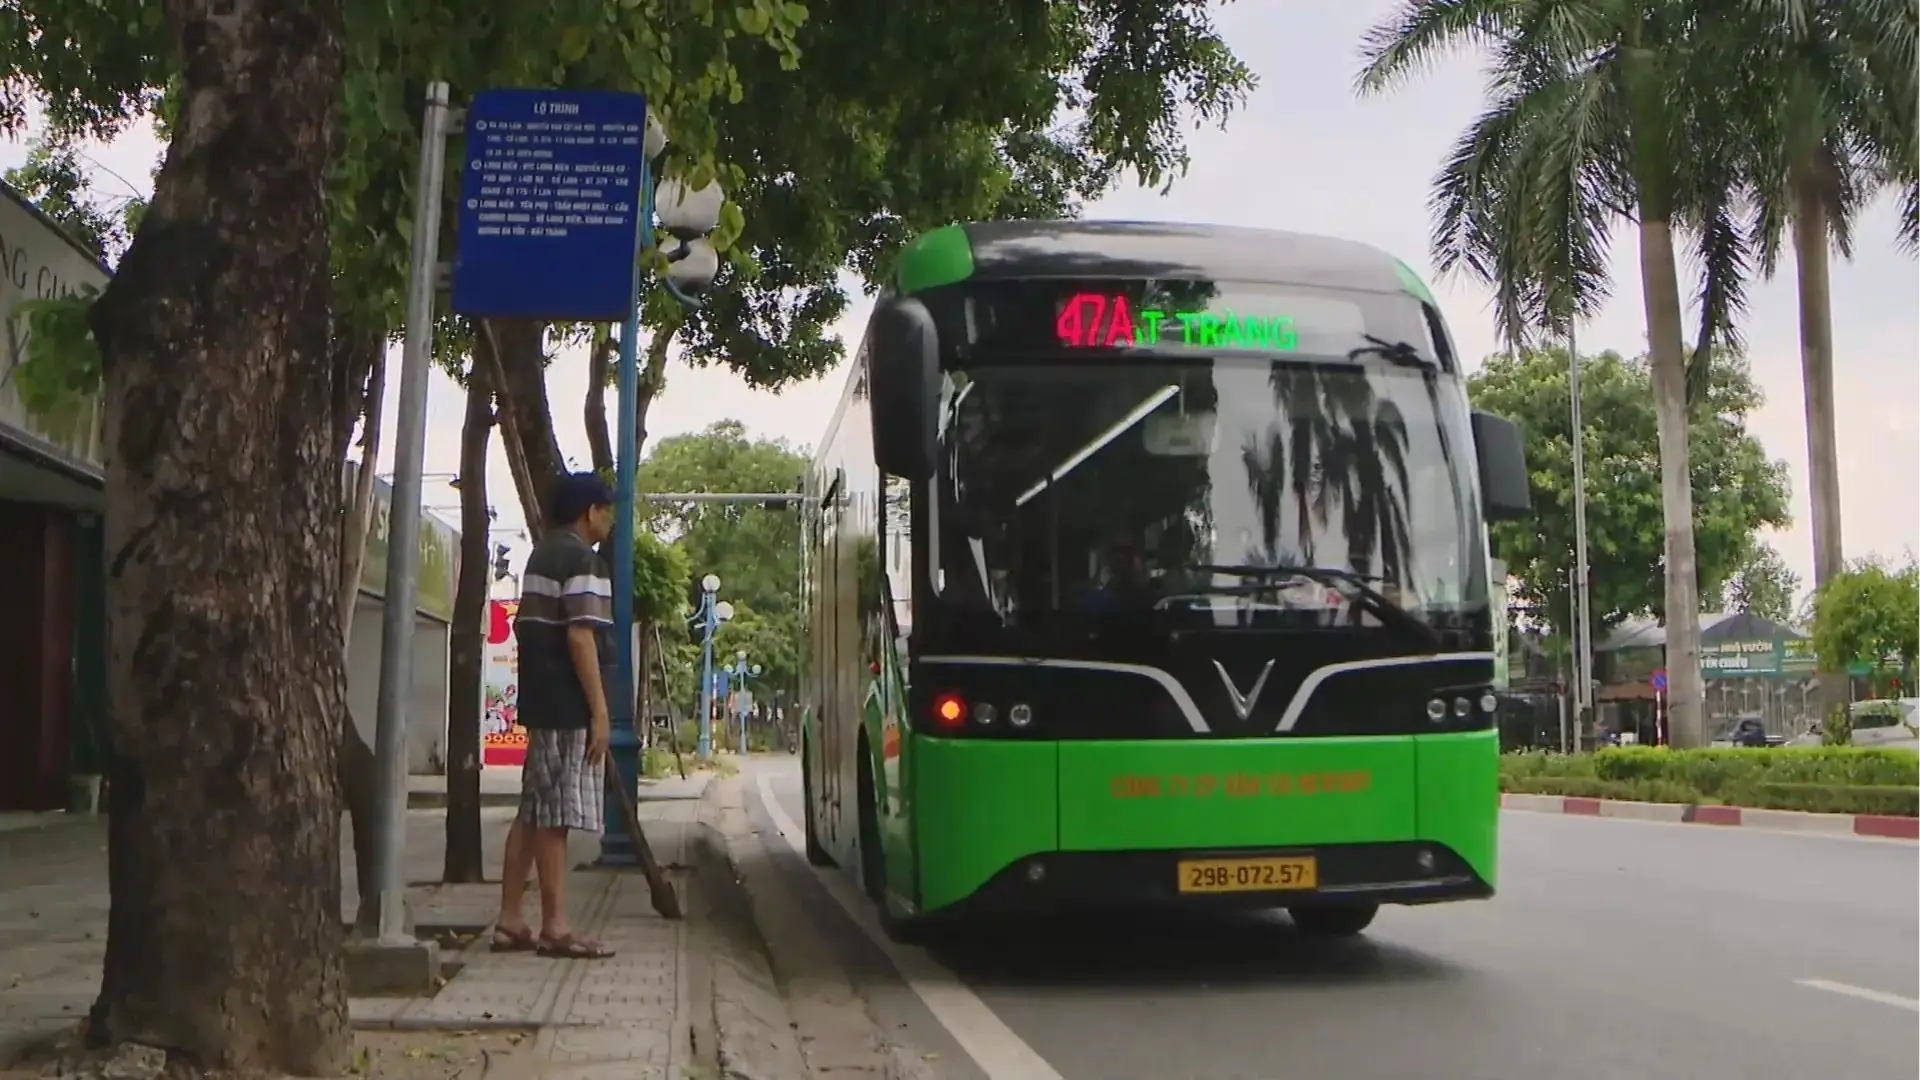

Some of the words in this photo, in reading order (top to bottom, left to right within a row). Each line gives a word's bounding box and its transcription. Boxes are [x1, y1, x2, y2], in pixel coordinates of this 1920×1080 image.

[1057, 292, 1134, 347] 47A
[1176, 307, 1297, 350] TRÀNG
[1190, 864, 1304, 888] 29B-072.57
